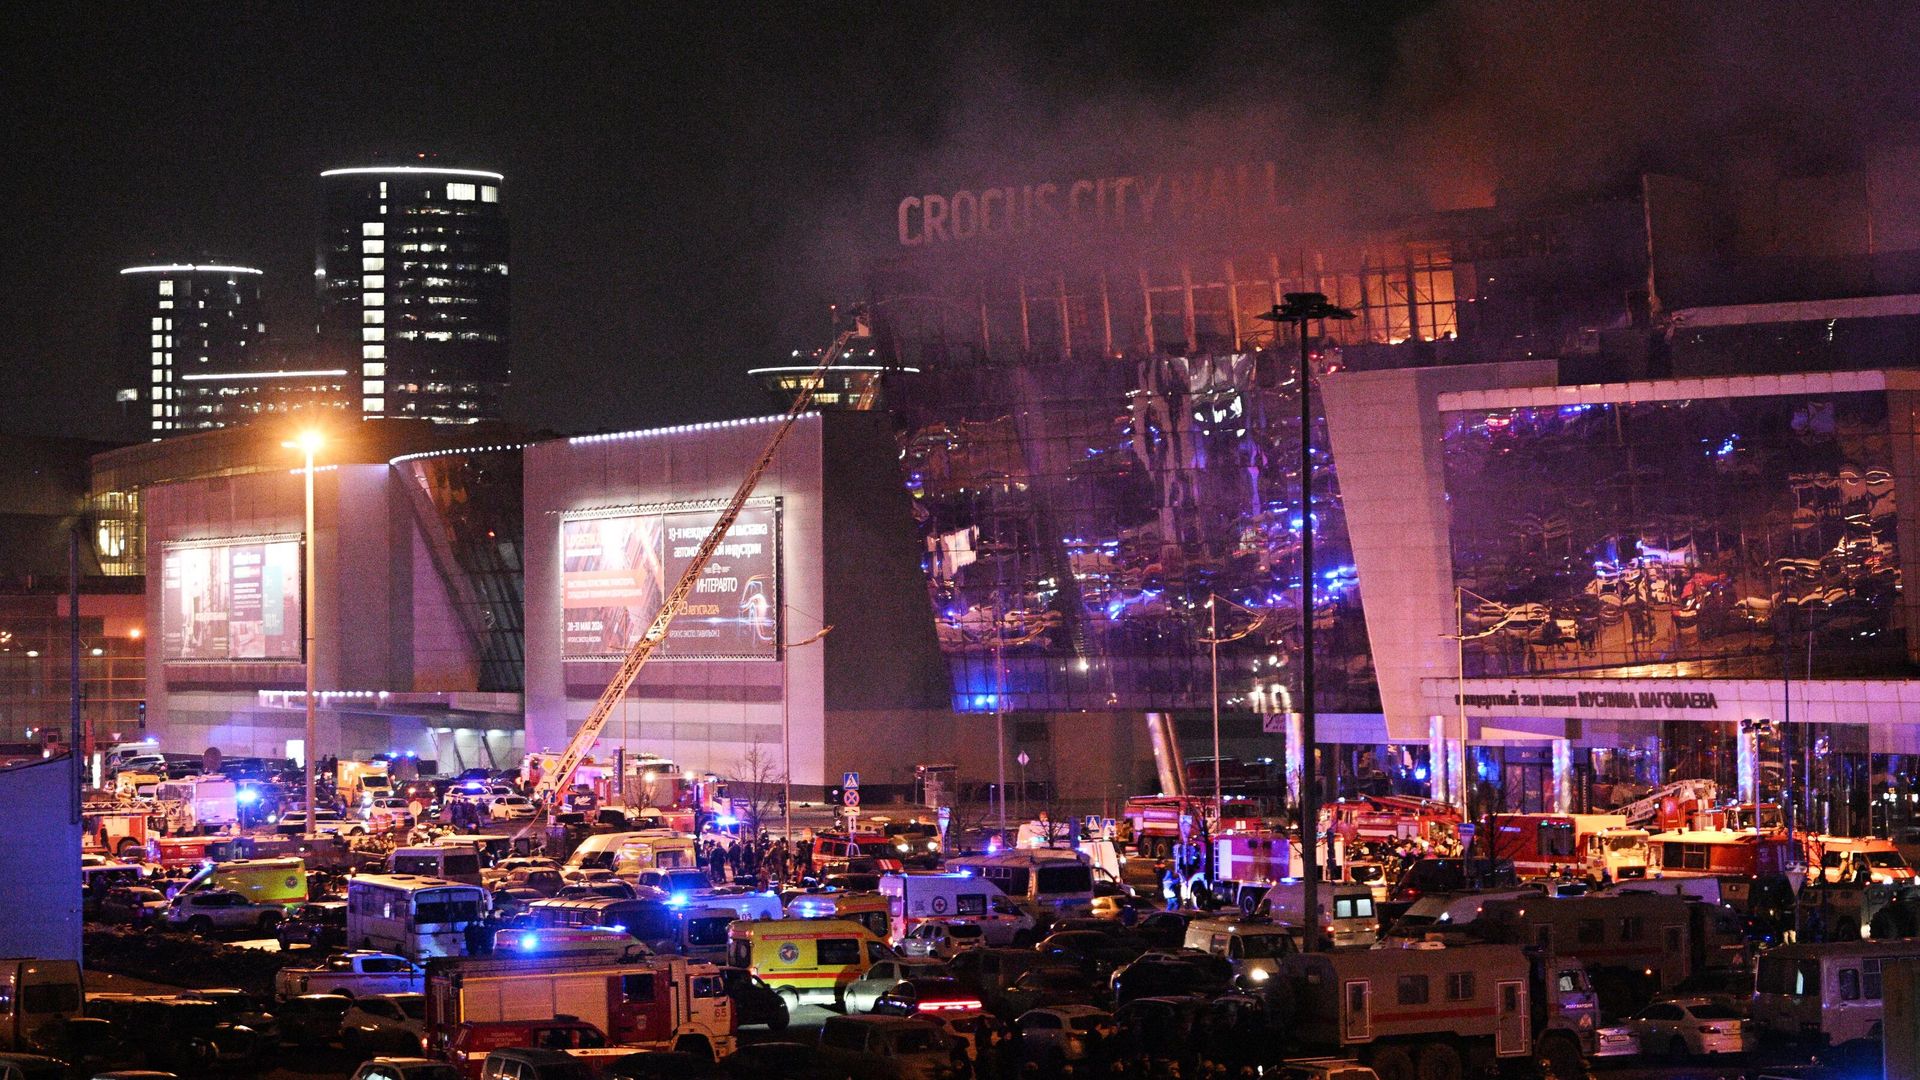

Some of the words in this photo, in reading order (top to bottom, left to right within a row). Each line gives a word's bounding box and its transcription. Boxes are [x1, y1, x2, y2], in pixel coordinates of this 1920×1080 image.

[896, 182, 1061, 247] CROCUS
[1068, 173, 1164, 229] CITY
[696, 577, 738, 593] ИНТЕРАВТО
[1520, 694, 1540, 706] зал
[1577, 691, 1638, 709] МУСЛИМА
[1638, 692, 1718, 709] МАГОМАЕВА
[714, 1008, 727, 1018] 65
